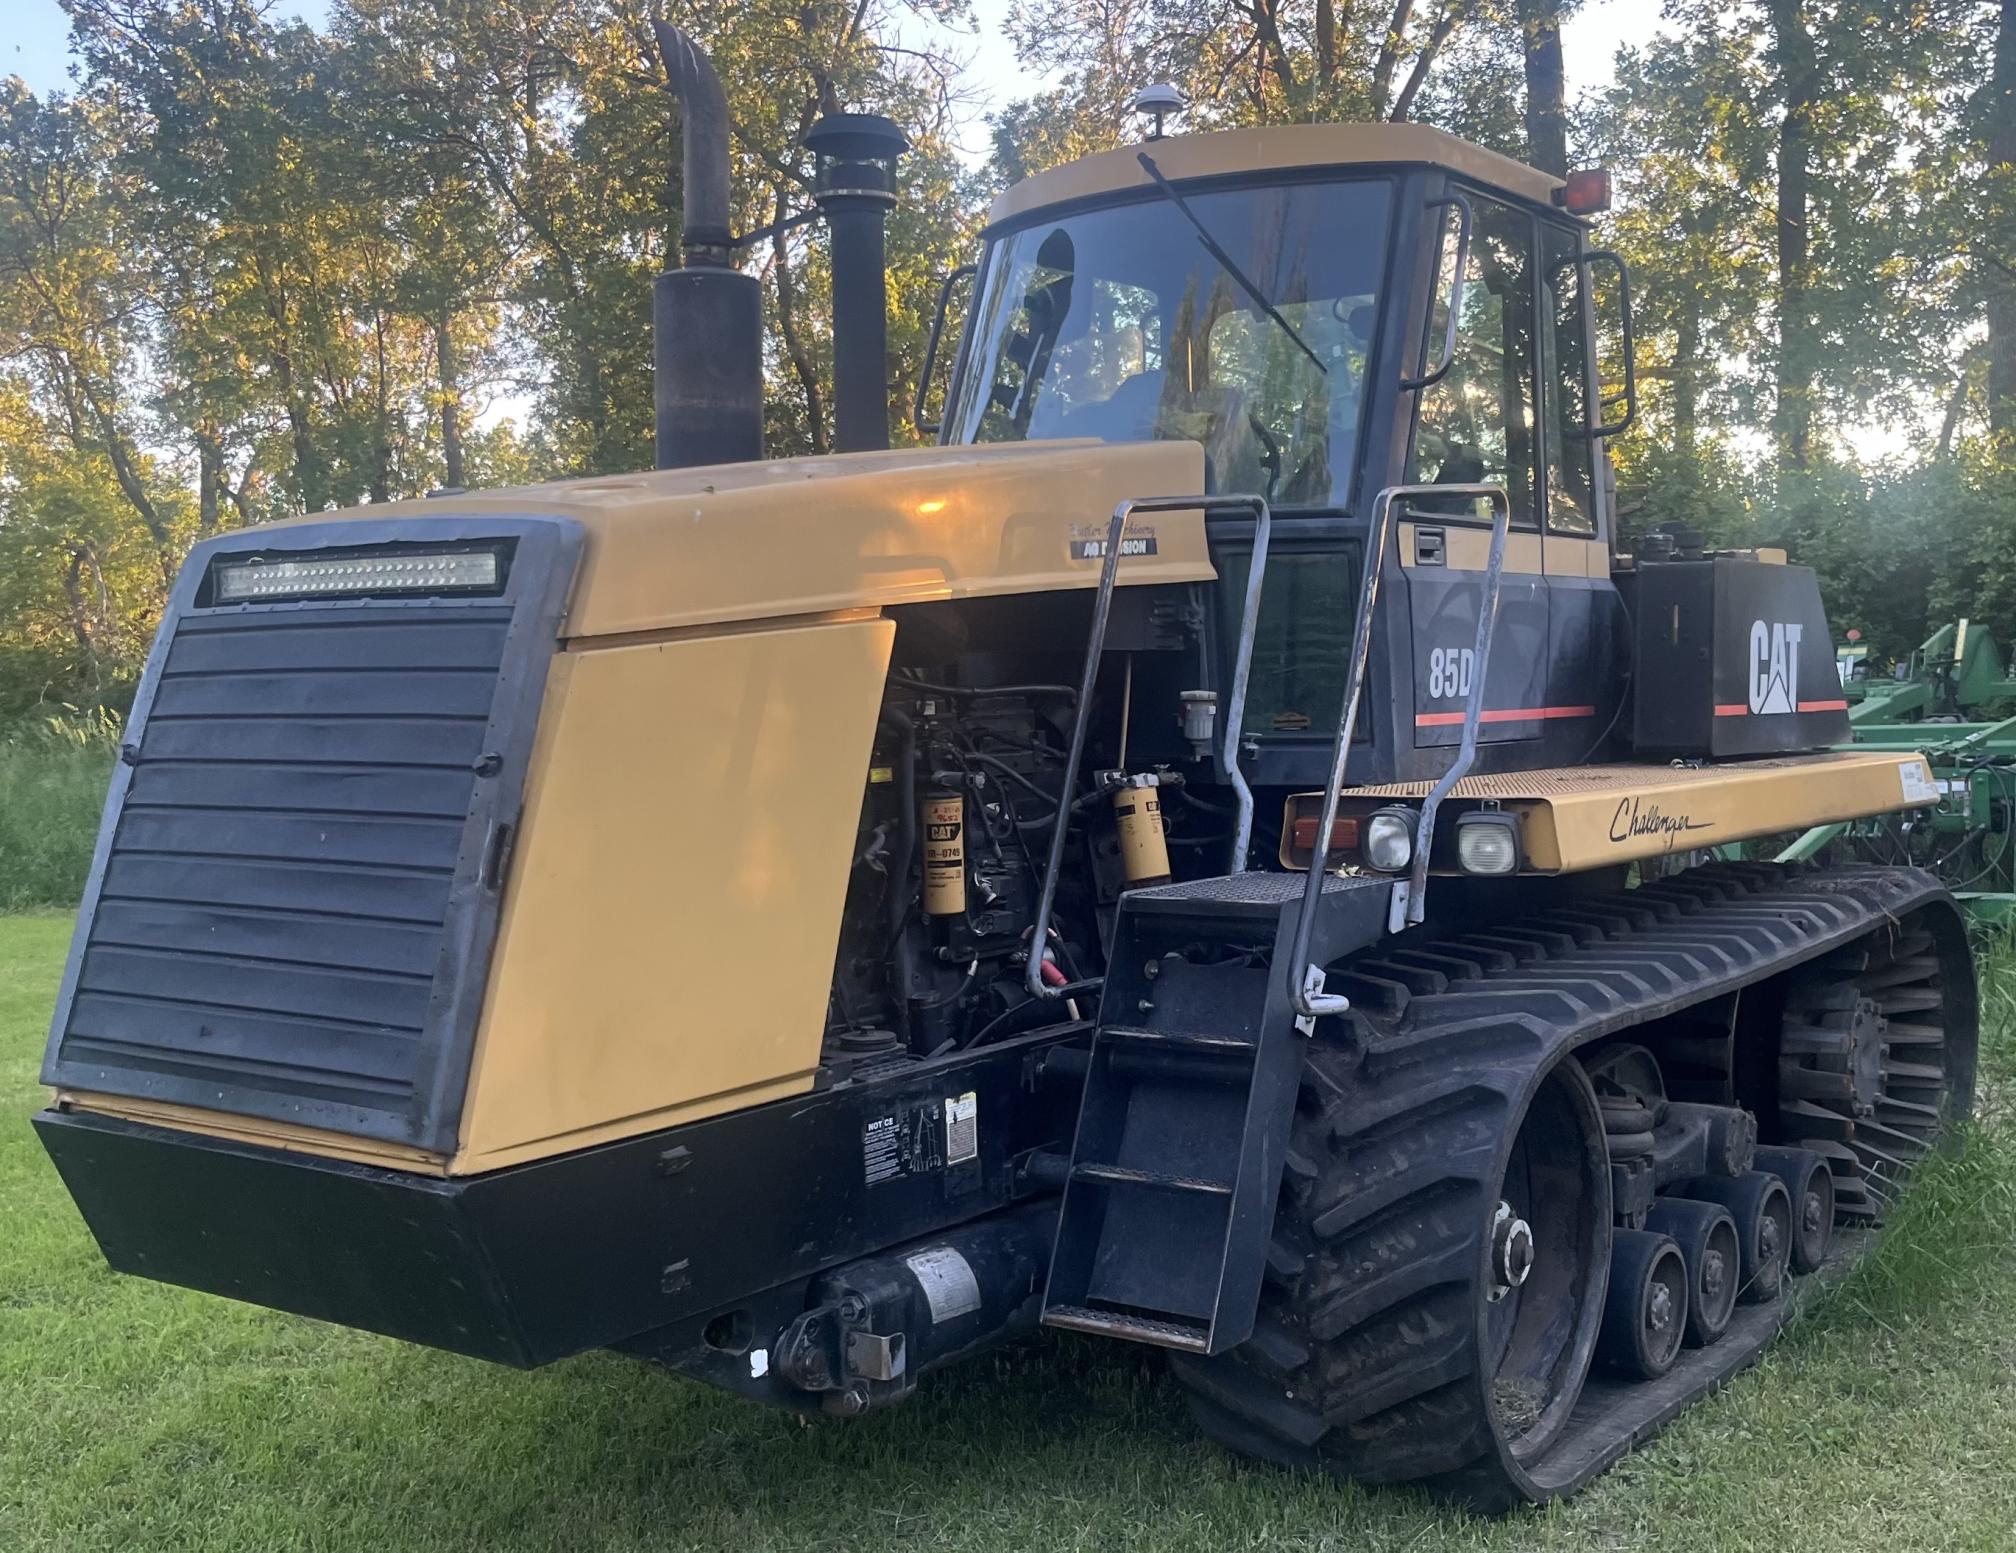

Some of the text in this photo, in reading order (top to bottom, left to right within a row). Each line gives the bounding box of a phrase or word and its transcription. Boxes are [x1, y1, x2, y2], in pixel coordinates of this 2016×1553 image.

[1429, 648, 1475, 699] 85D
[1749, 620, 1803, 714] CAT
[931, 826, 953, 840] CAT
[1609, 796, 1716, 850] Challenger
